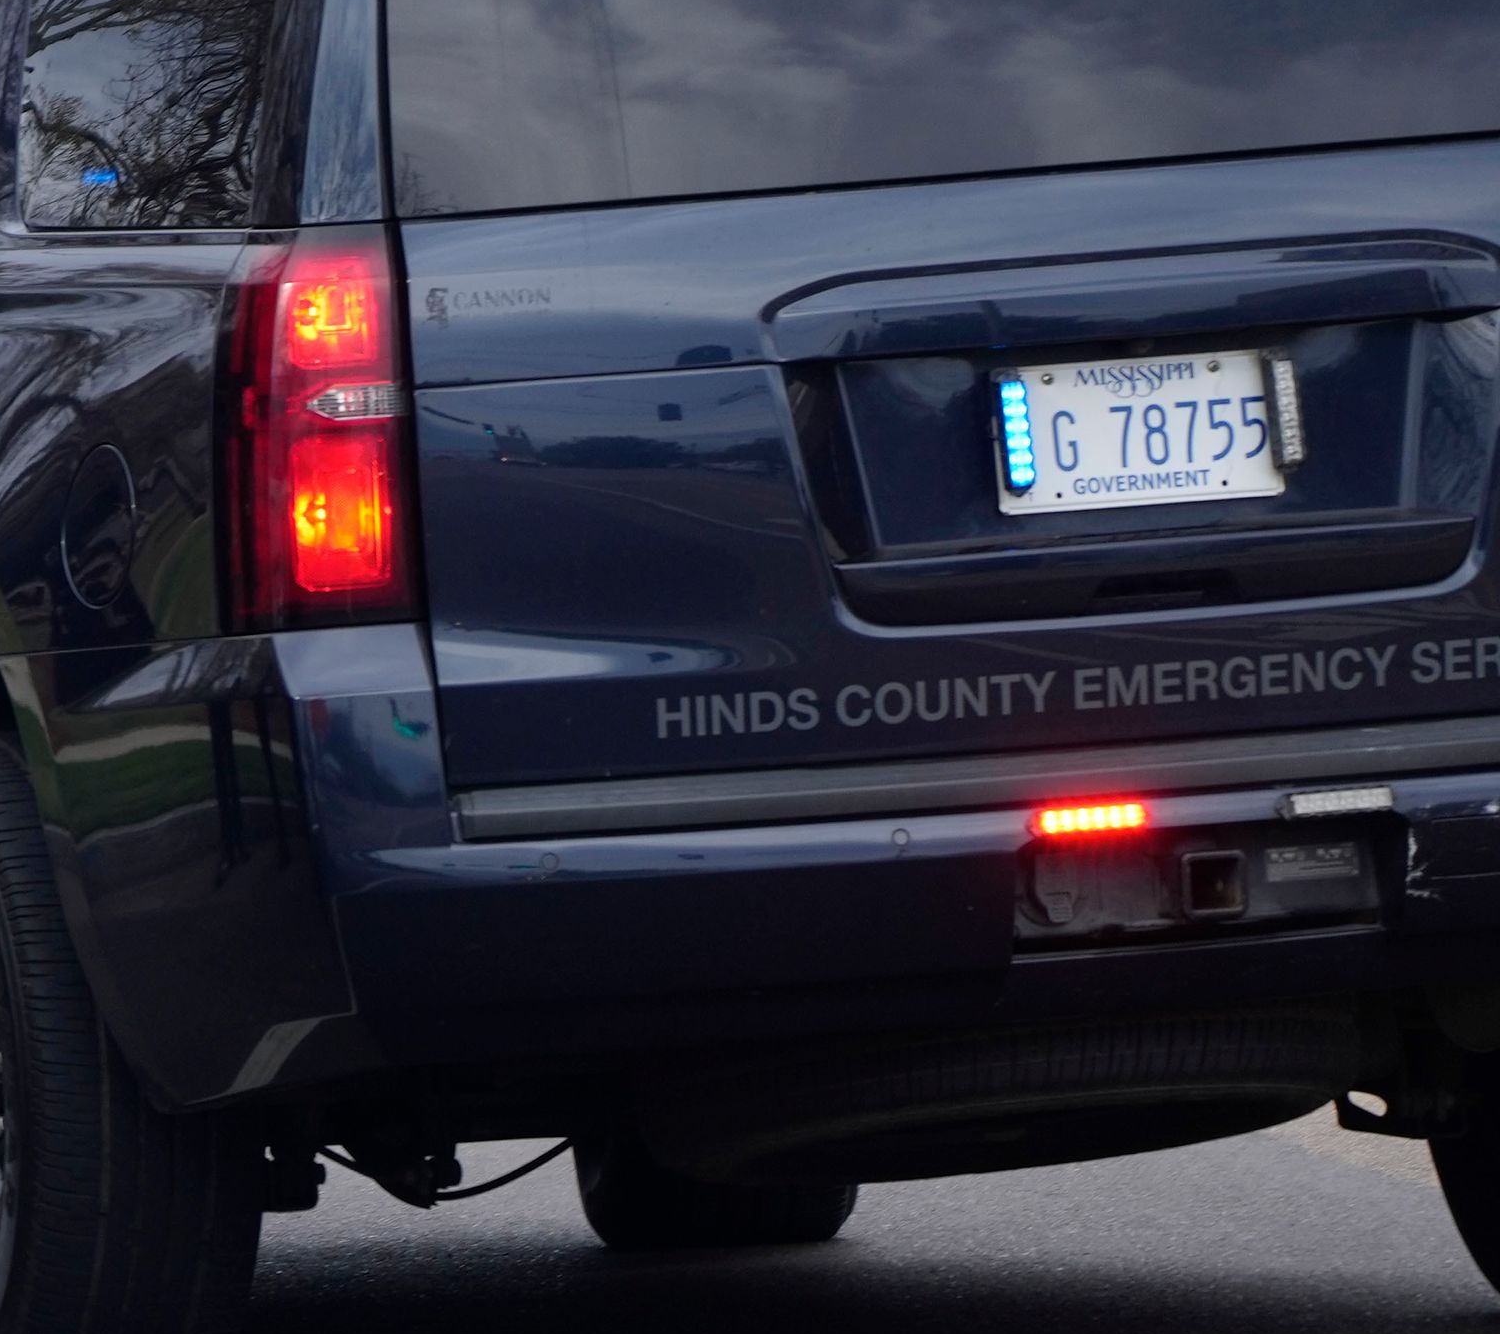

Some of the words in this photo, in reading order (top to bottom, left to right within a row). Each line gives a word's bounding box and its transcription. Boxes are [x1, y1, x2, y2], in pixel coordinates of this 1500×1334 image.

[453, 286, 552, 312] CANNON
[1073, 361, 1195, 398] MISSISSIPPI
[1052, 410, 1079, 473] G
[1108, 395, 1270, 470] 78755
[1073, 469, 1211, 496] GOVERNMENT
[655, 687, 820, 739] HINDS
[835, 671, 1055, 728] COUNTY
[1073, 643, 1406, 711] EMERGENCY
